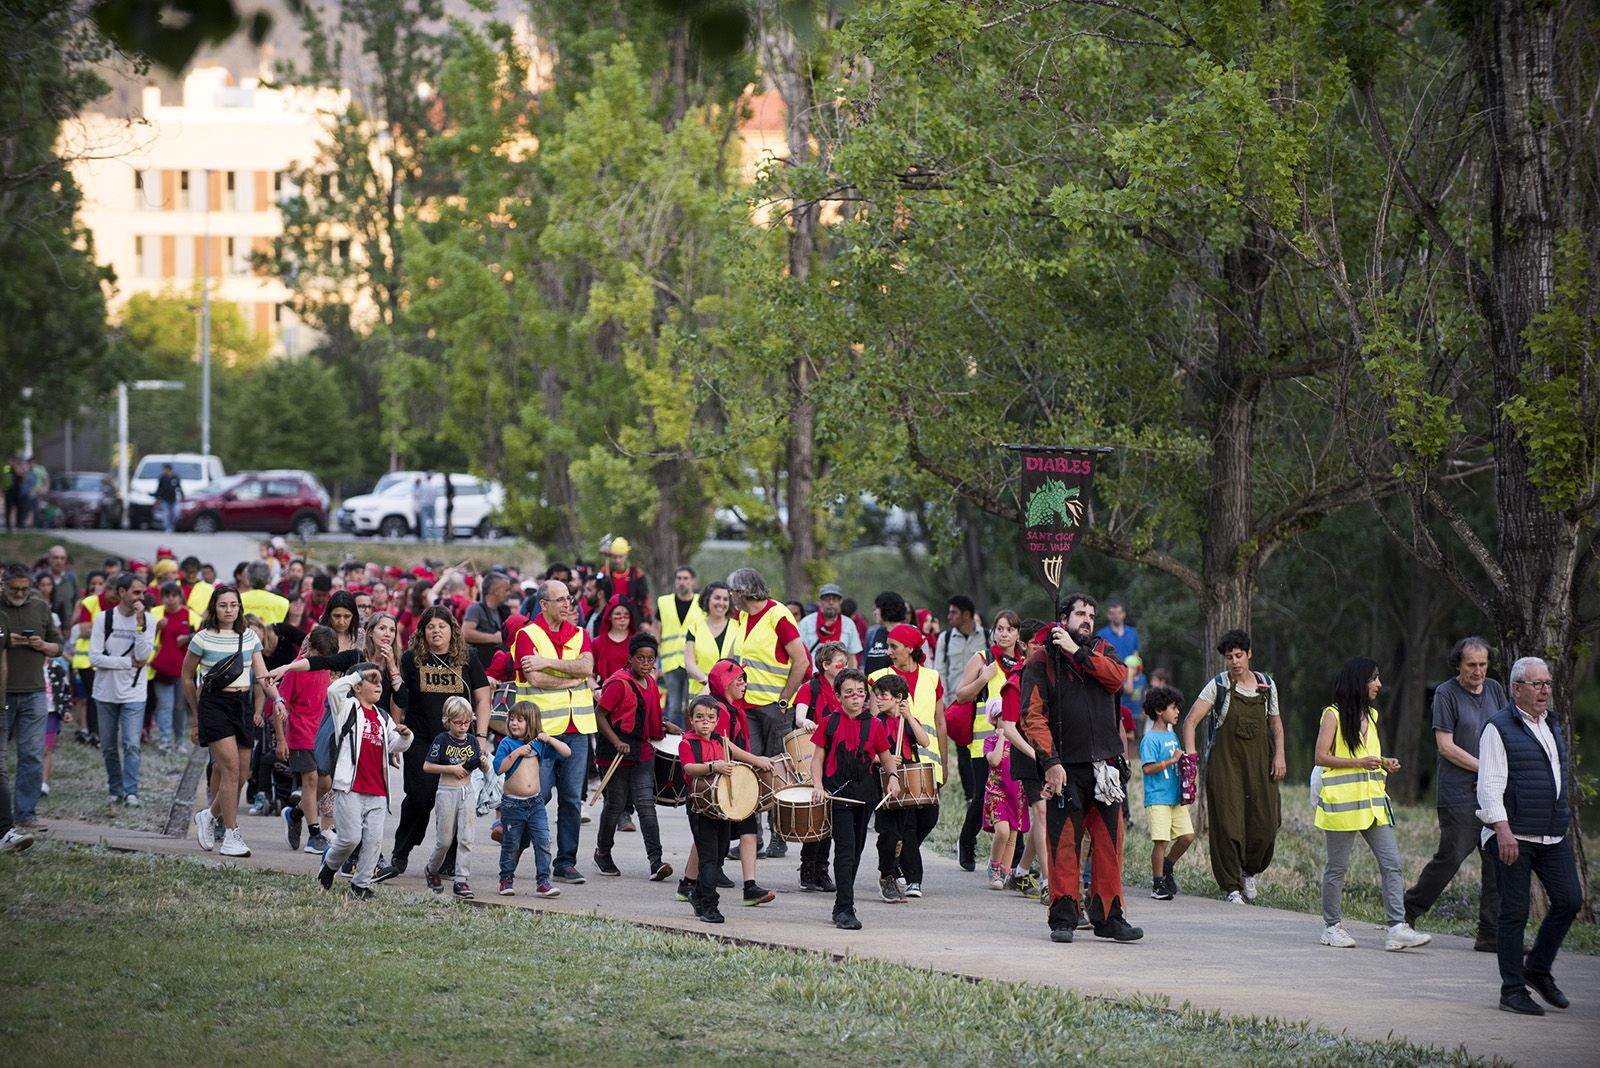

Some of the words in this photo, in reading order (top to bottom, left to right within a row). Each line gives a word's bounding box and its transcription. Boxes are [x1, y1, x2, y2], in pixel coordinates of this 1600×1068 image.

[1025, 457, 1091, 474] DIABLES
[1027, 531, 1053, 541] SANT
[1030, 543, 1047, 551] DEL
[425, 672, 457, 686] LOST
[445, 744, 475, 759] NICE
